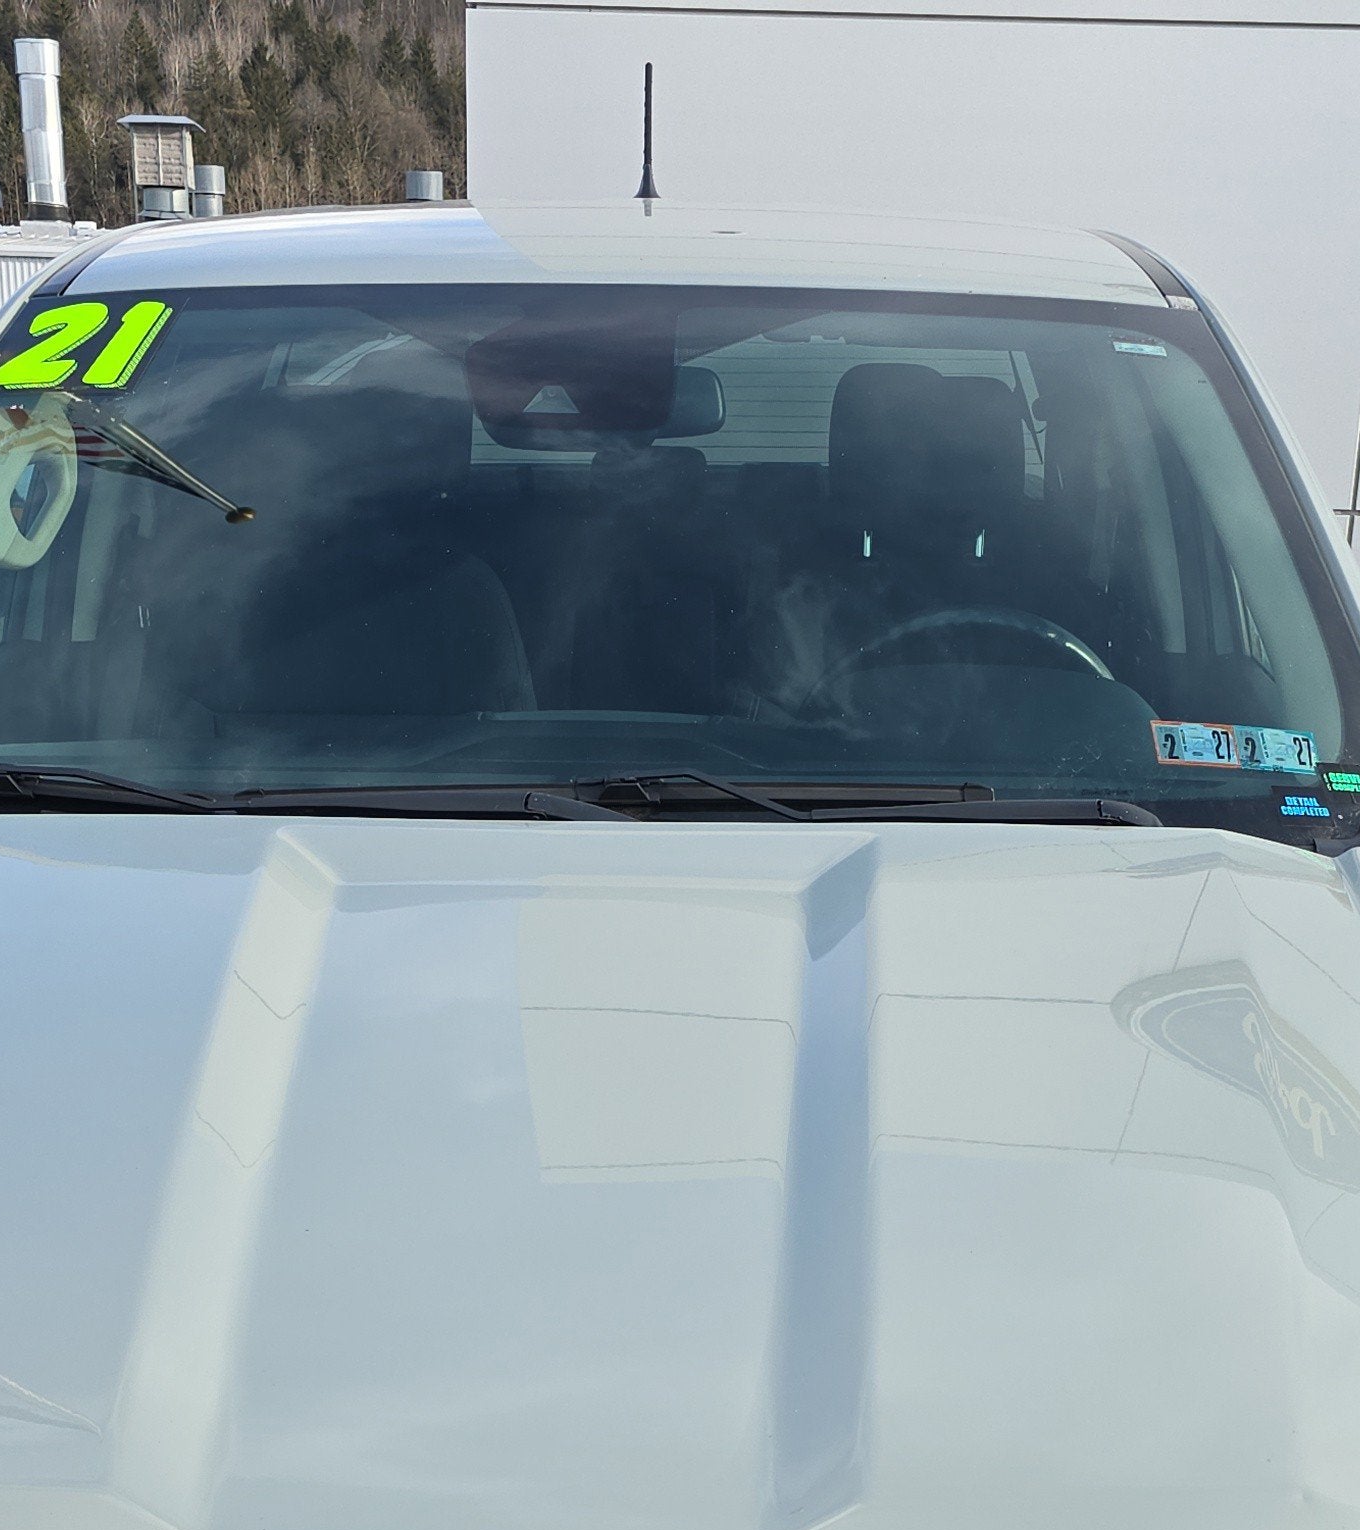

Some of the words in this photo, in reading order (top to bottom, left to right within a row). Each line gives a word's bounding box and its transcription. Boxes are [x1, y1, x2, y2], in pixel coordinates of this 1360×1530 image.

[1165, 733, 1180, 760] 2
[1211, 730, 1232, 762] 27
[1244, 736, 1261, 763] 2
[1293, 737, 1313, 768] 27
[1280, 805, 1331, 817] COMPLETED
[1284, 796, 1320, 807] DETAIL
